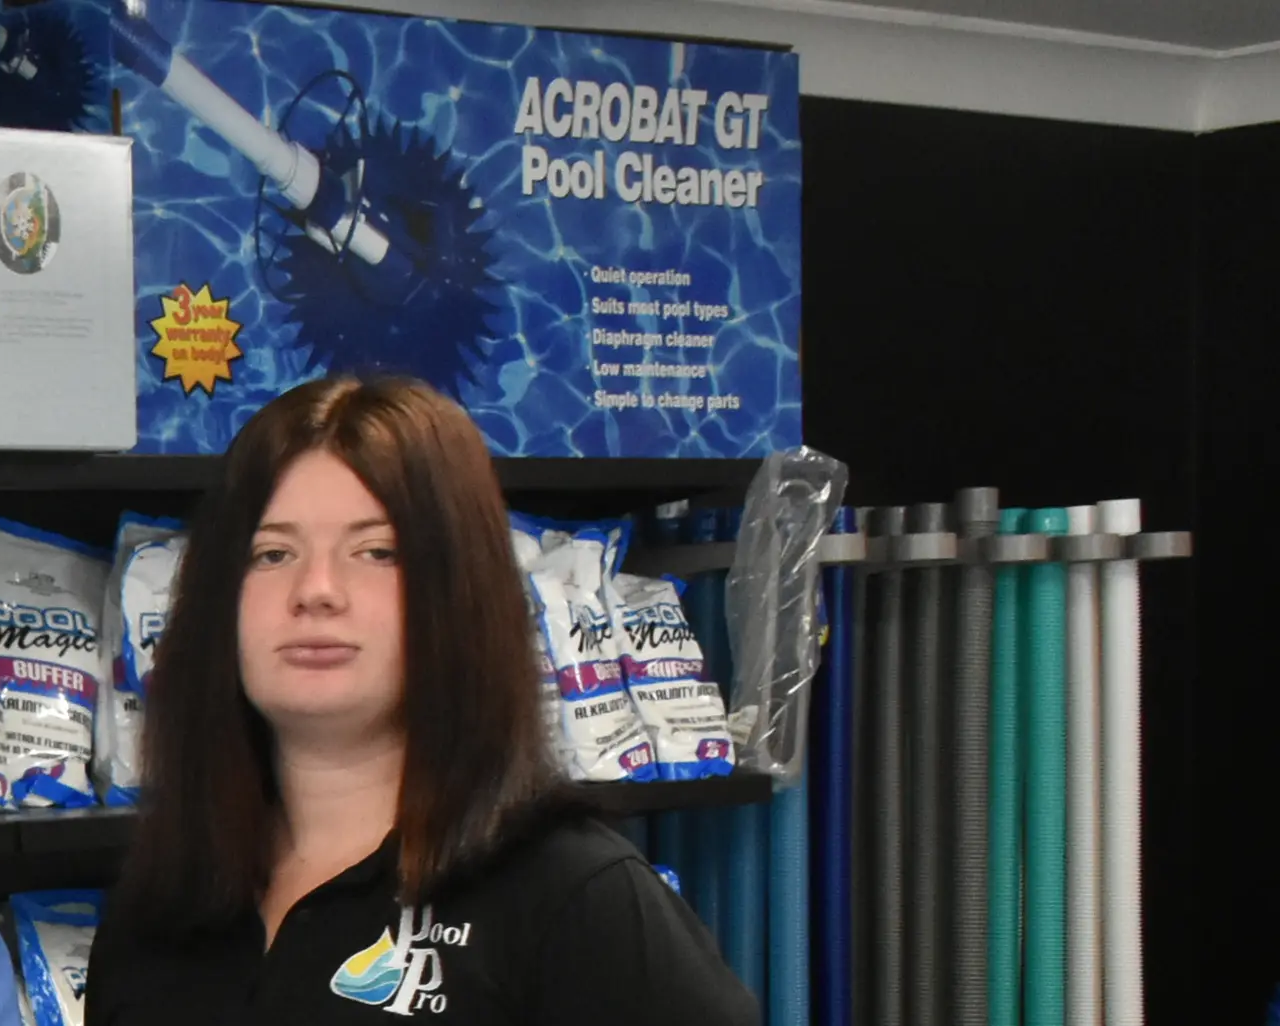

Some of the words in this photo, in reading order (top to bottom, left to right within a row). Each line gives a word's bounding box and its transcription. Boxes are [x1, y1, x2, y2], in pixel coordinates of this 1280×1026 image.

[514, 76, 708, 146] ACROBAT
[715, 91, 768, 149] GT
[522, 145, 606, 200] Pool
[615, 151, 764, 208] Cleaner
[591, 265, 626, 283] Quiet
[629, 268, 691, 288] operation
[172, 285, 192, 325] 3
[592, 297, 625, 315] Suits
[628, 301, 661, 316] most
[663, 301, 691, 319] pool
[693, 302, 729, 321] types
[593, 328, 663, 349] Diaphragm
[665, 331, 715, 348] cleaner
[594, 360, 620, 376] Low
[623, 361, 707, 378] maintenance
[594, 389, 639, 411] Simple
[641, 392, 656, 408] to
[658, 391, 704, 412] change
[707, 396, 740, 412] parts
[12, 659, 85, 692] BUFFER
[381, 899, 472, 968] Pool
[383, 948, 448, 1016] Pro
